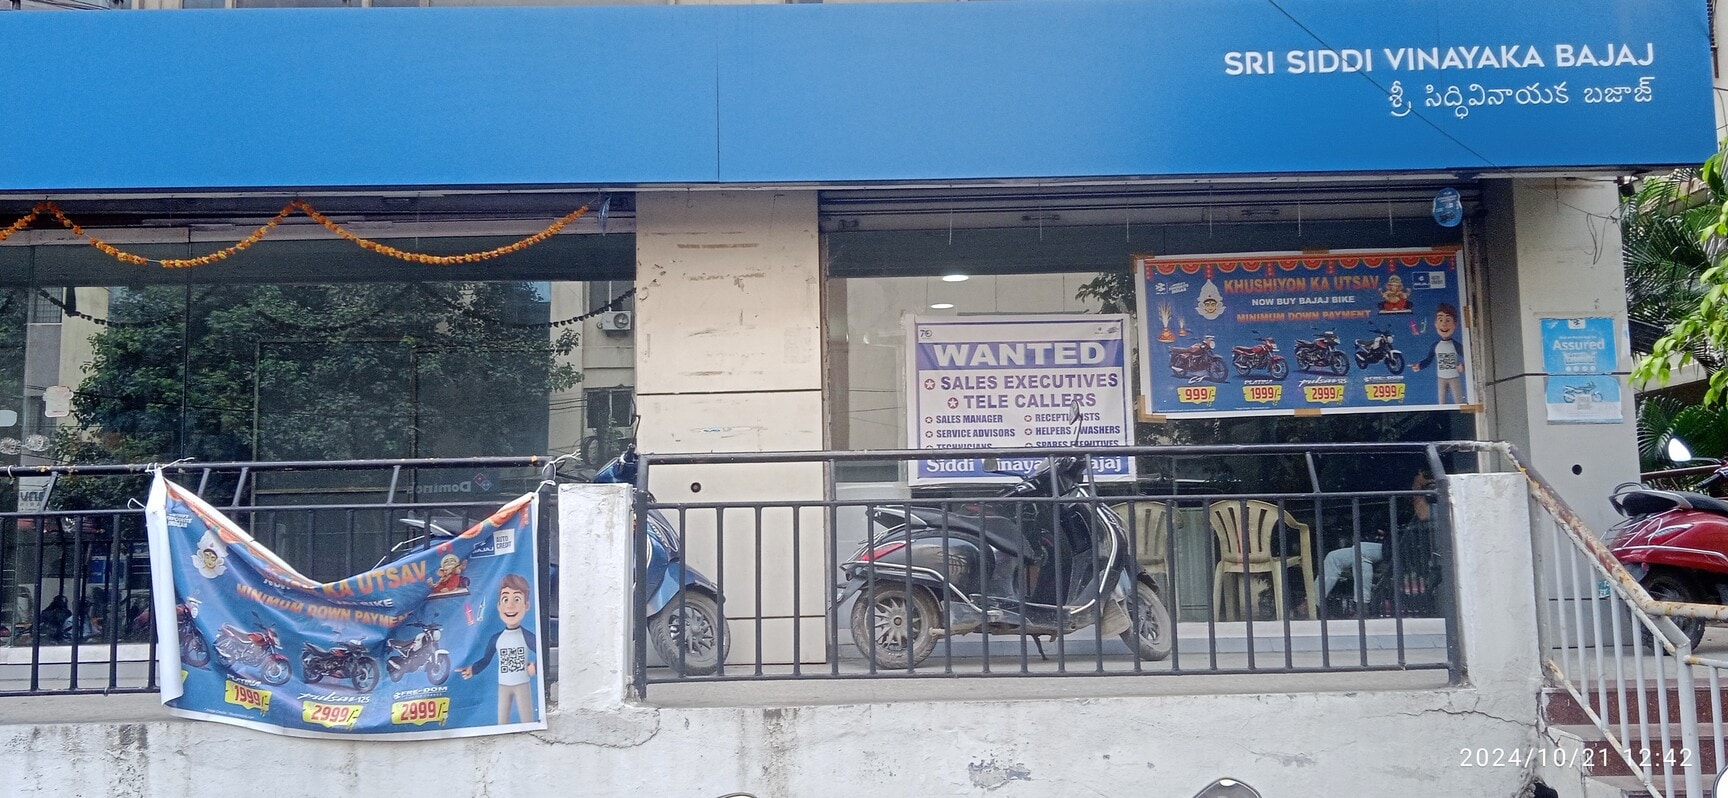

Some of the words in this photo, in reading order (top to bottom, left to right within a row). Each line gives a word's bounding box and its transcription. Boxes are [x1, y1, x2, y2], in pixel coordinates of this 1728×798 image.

[1224, 50, 1275, 75] SRI
[1286, 47, 1373, 74] SIDDI
[1383, 44, 1546, 71] VINAYAKA
[1555, 42, 1655, 69] BAJAJ
[1389, 80, 1412, 117] శ్రీ
[1425, 82, 1570, 119] సిద్ధివినాయక
[1583, 77, 1656, 105] బజాజ్
[1224, 277, 1306, 294] KHUSHIYON
[1309, 276, 1330, 291] KA
[1333, 275, 1379, 290] UTSAV
[1252, 298, 1275, 306] NOW
[1276, 297, 1297, 305] BUY
[1299, 296, 1330, 304] BAJAJ
[1236, 313, 1286, 323] MINIMUM
[1287, 311, 1320, 321] DOWN
[1322, 310, 1372, 319] PAYMENT
[1553, 338, 1605, 351] Assured
[933, 341, 1106, 367] WANTED
[940, 375, 998, 390] SALES
[1003, 373, 1119, 389] EXECUTIVES
[963, 394, 1009, 409] TELE
[1014, 393, 1097, 408] CALLERS
[936, 415, 961, 424] SALES
[963, 414, 1003, 423] MANAGER
[1035, 413, 1101, 422] RECEPTIISTS
[936, 429, 971, 438] SERVICE
[972, 428, 1016, 438] ADVISORS
[1035, 426, 1072, 436] HELPERS
[1079, 425, 1121, 435] WASHERS
[926, 458, 975, 473] Siddi
[1091, 457, 1122, 473] ajaj
[358, 560, 427, 595] UTSAV
[236, 583, 304, 614] MINIMUM
[306, 603, 351, 621] DOWN
[234, 684, 269, 707] 1999/-
[311, 704, 359, 723] 2999/-
[401, 700, 448, 721] 2999/-
